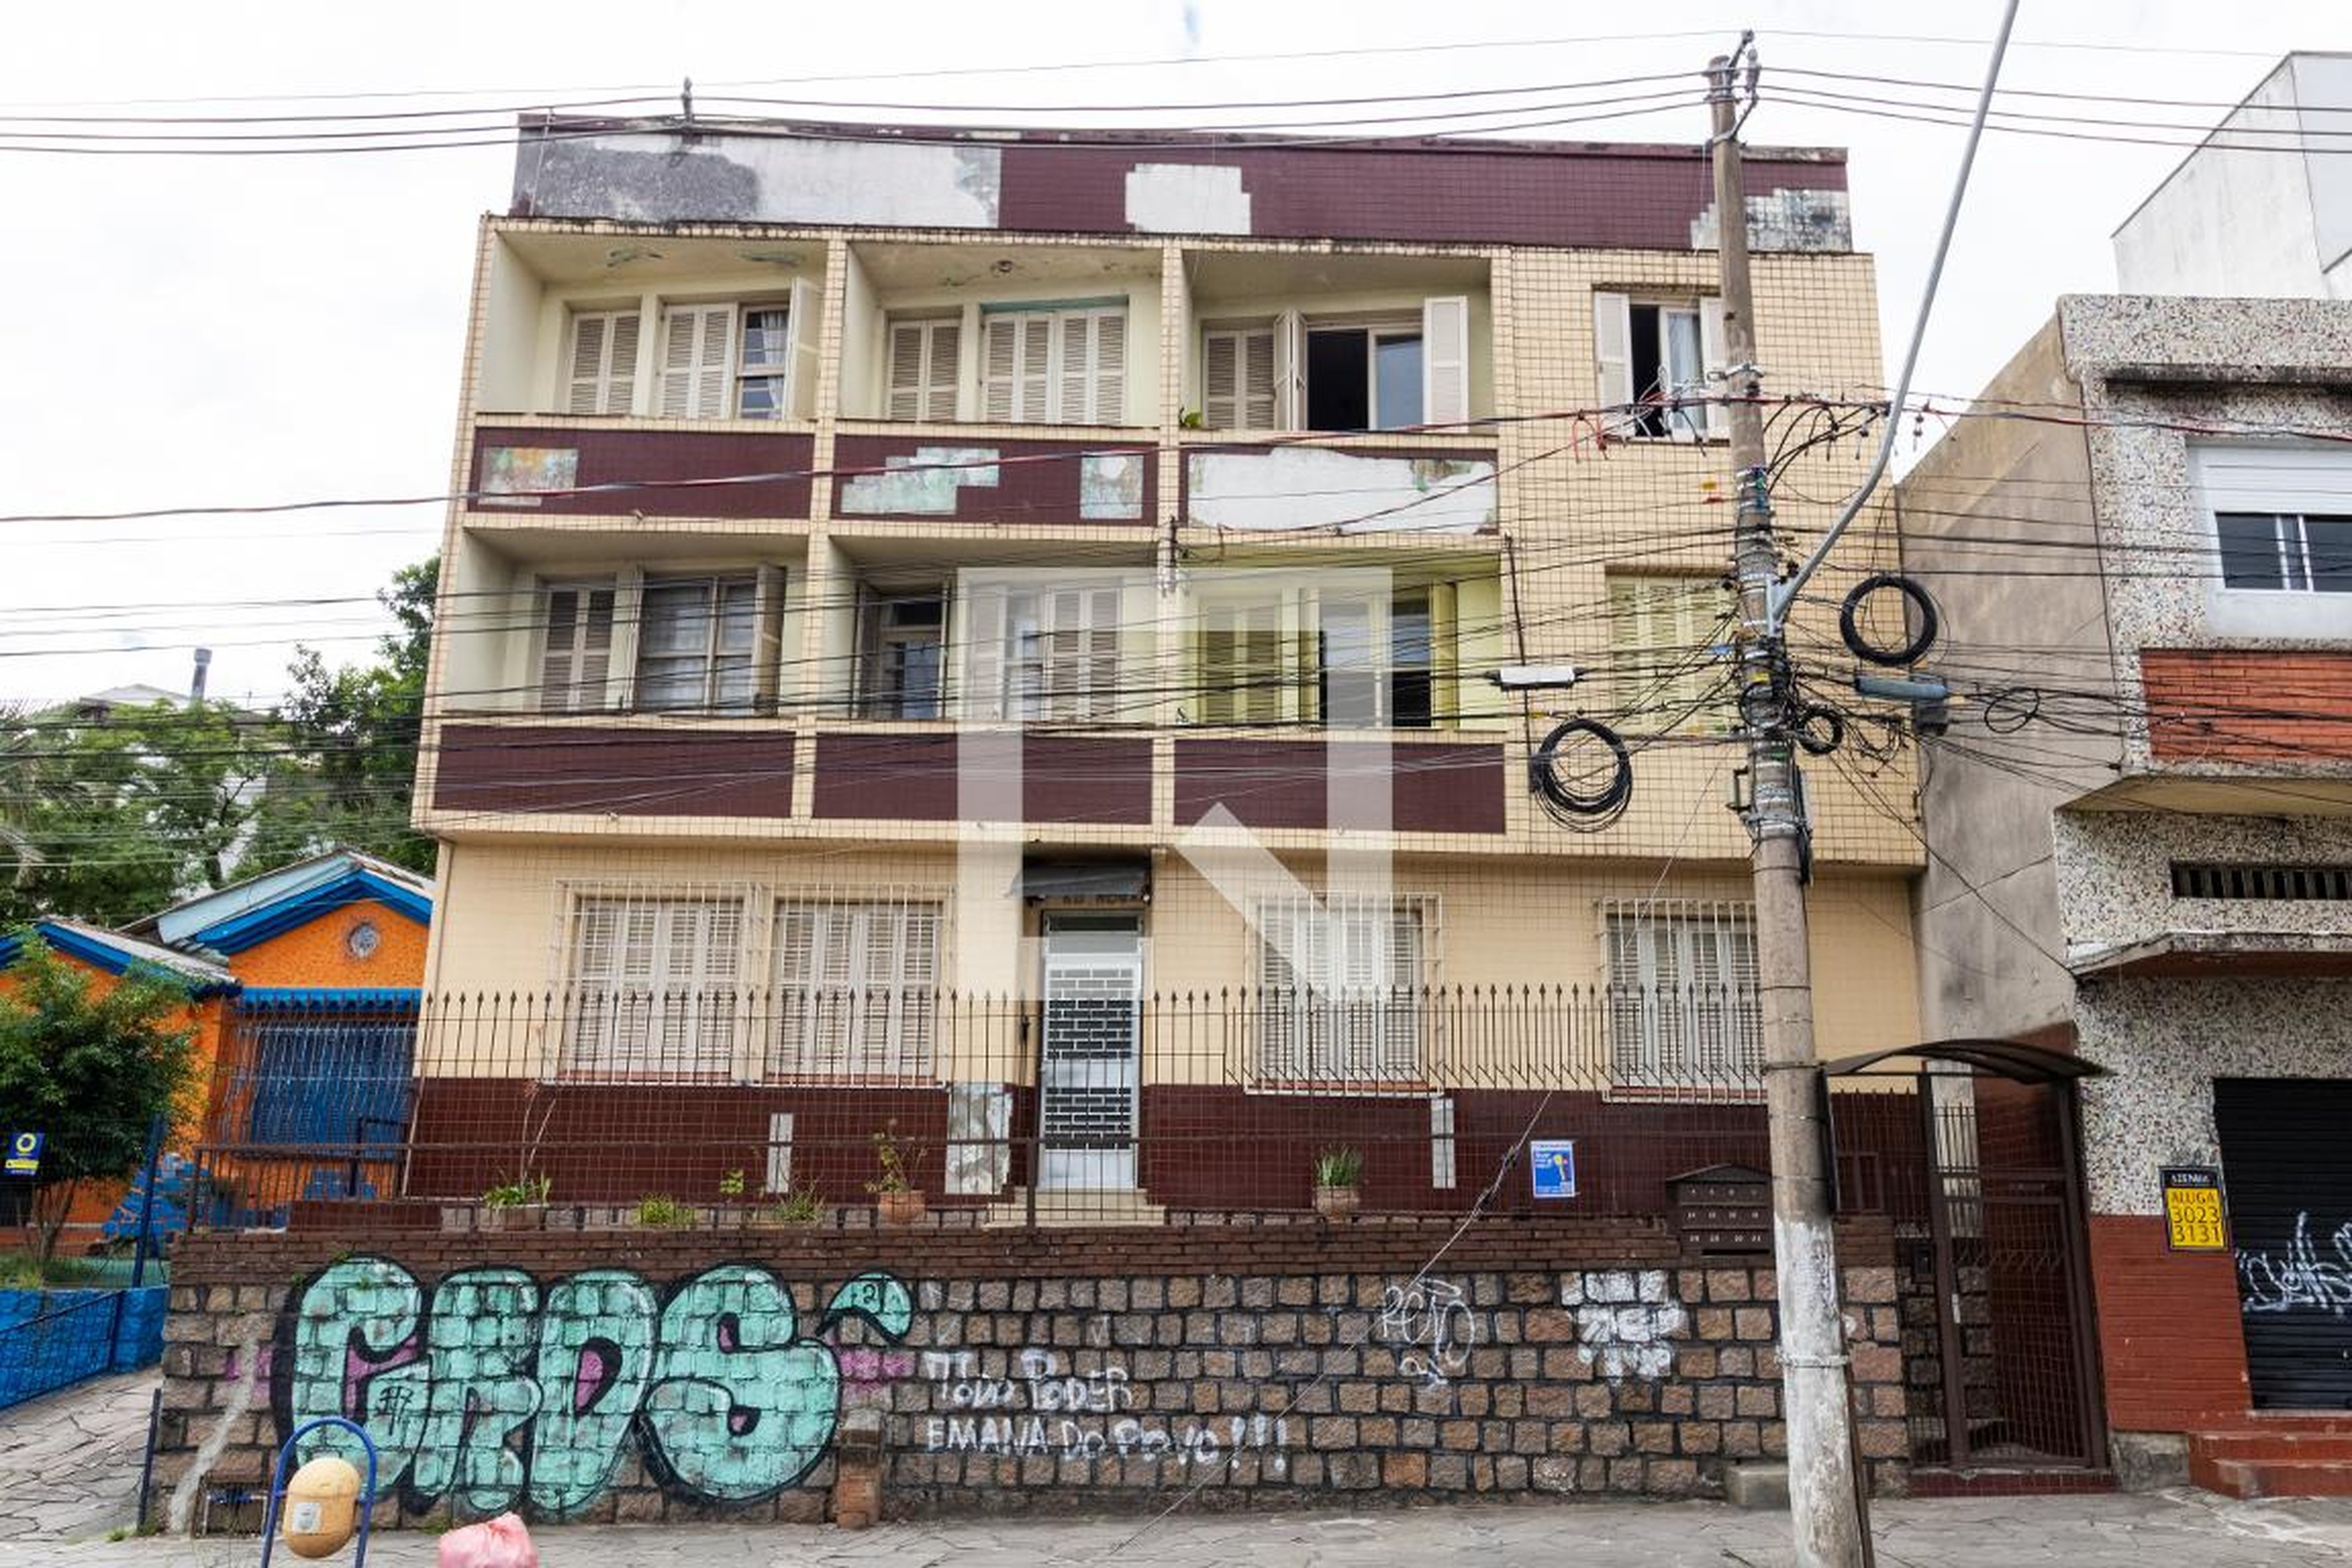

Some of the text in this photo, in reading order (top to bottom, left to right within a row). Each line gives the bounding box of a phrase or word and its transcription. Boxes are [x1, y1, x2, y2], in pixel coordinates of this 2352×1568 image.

[2171, 1191, 2215, 1205] ALUGA
[2173, 1205, 2220, 1224] 3023
[2174, 1224, 2221, 1243] 3131
